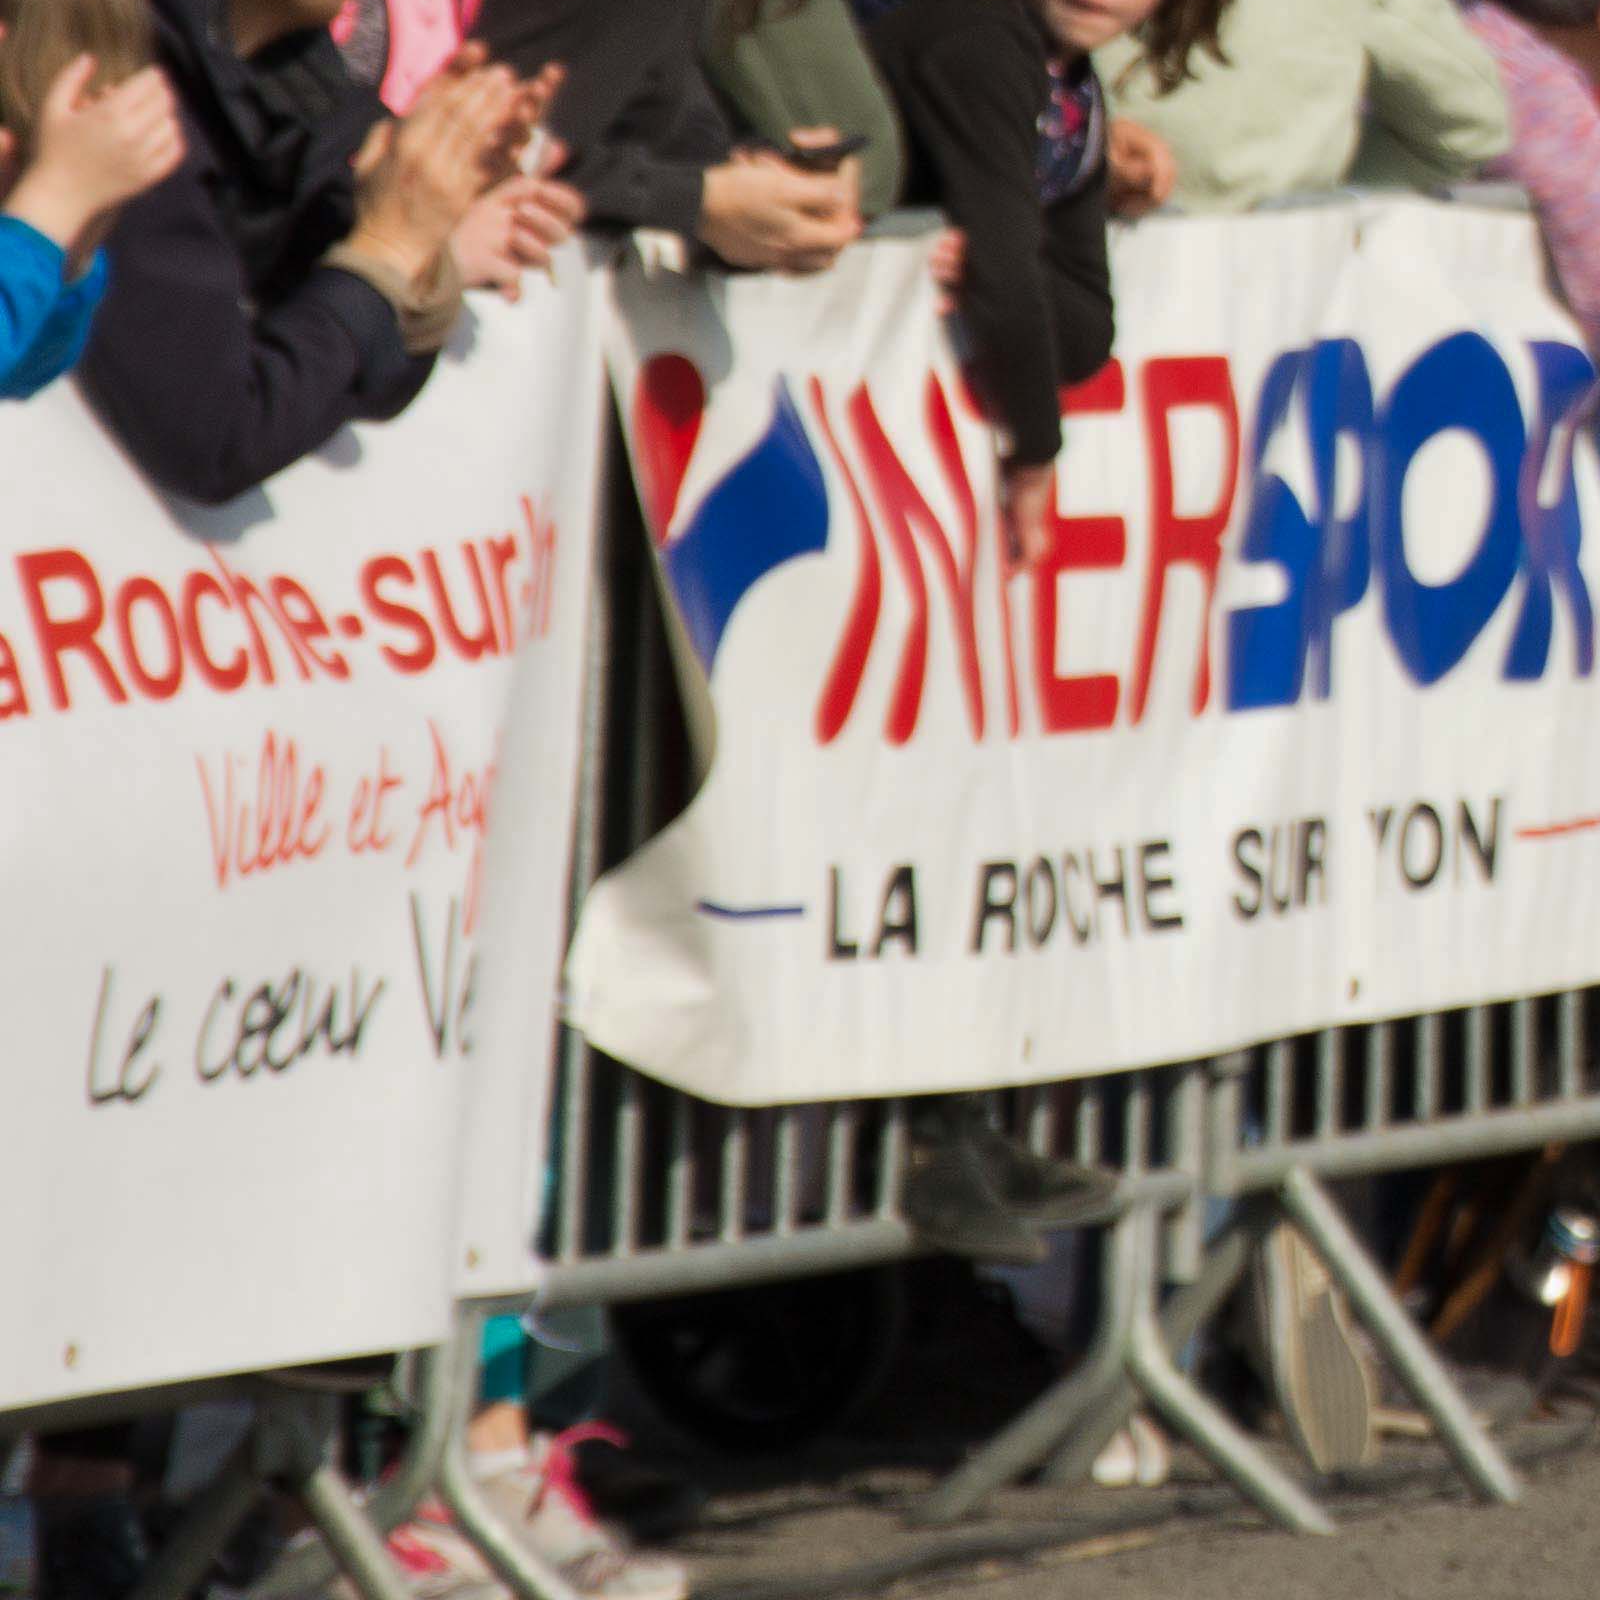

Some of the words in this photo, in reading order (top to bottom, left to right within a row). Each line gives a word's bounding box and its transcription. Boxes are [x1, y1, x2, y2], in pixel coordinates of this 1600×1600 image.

[196, 726, 328, 893] Ville
[346, 746, 402, 855] et
[824, 862, 920, 962] LA
[966, 838, 1185, 956] ROCHE
[1230, 814, 1330, 920] SUR
[1367, 795, 1506, 893] YON
[86, 962, 163, 1105] Le
